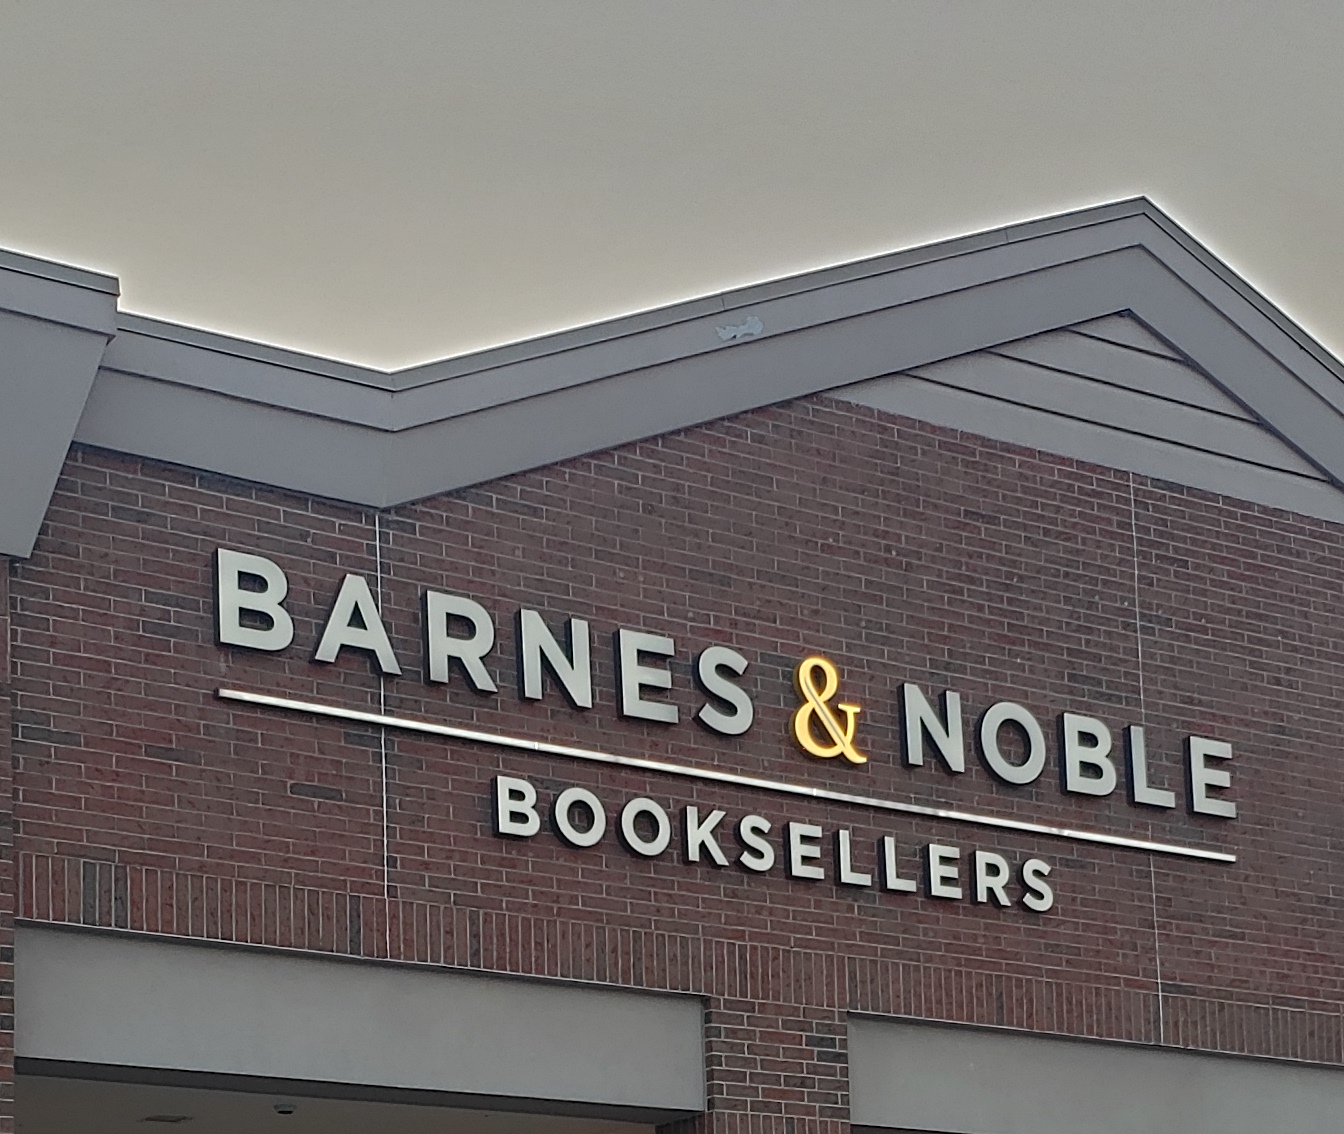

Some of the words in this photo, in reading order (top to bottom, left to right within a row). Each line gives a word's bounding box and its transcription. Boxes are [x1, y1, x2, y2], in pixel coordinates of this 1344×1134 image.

[214, 547, 755, 736] BARNES
[791, 655, 867, 764] &
[902, 681, 1238, 820] NOBLE
[494, 774, 1055, 913] BOOKSELLERS
